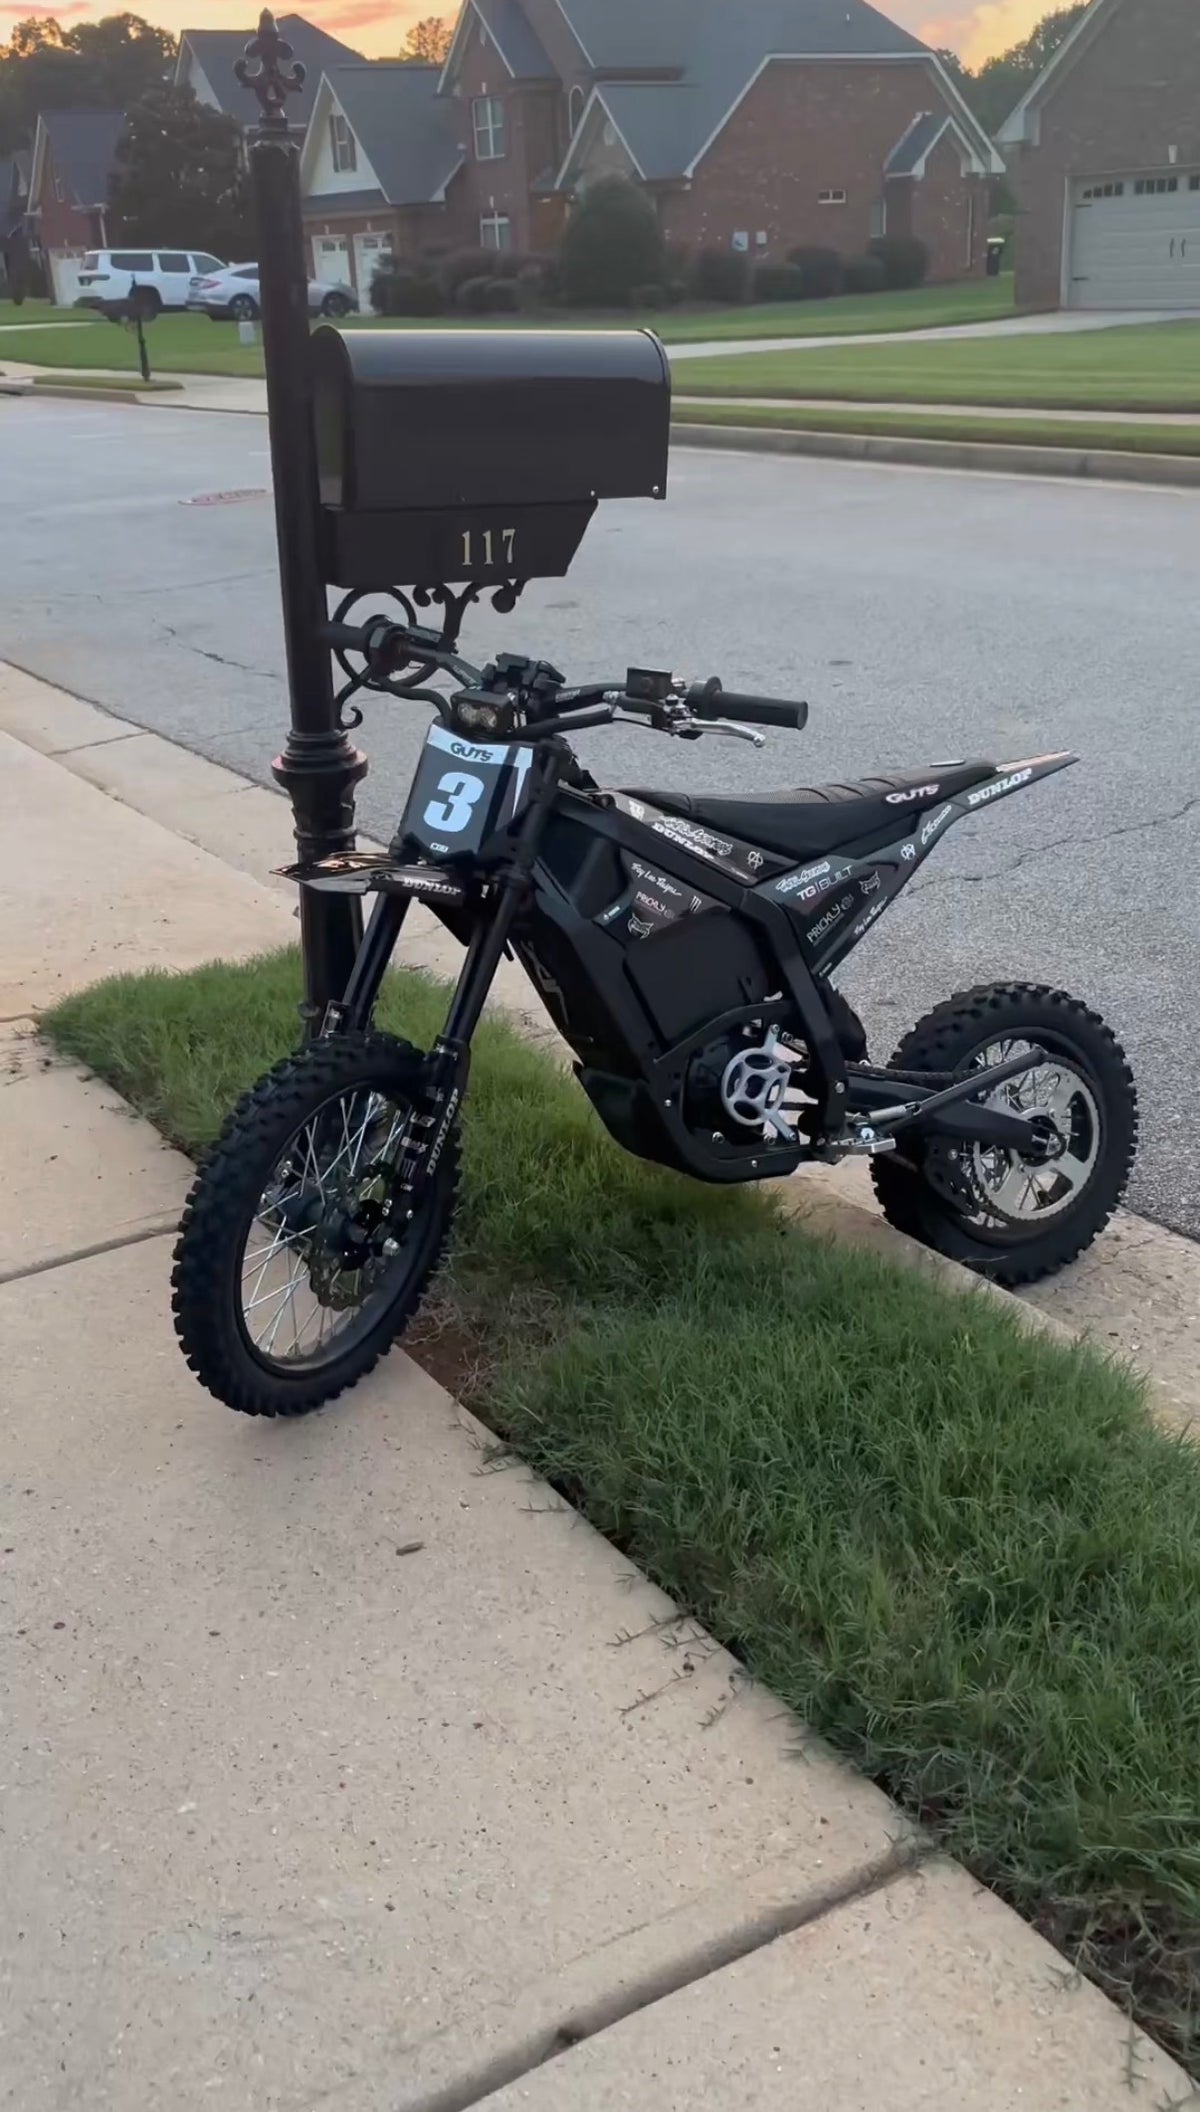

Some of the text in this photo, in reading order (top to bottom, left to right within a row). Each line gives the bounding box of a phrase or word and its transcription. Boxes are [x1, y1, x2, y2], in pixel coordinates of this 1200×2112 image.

[462, 528, 515, 565] 117
[450, 741, 494, 762] GUTS
[423, 771, 485, 832] 3
[885, 784, 940, 803] GUTS
[967, 767, 1032, 805] DUNLOP
[402, 877, 461, 896] DUNLOP
[806, 903, 841, 943] PRICKLY
[426, 1088, 458, 1176] DUNLOP
